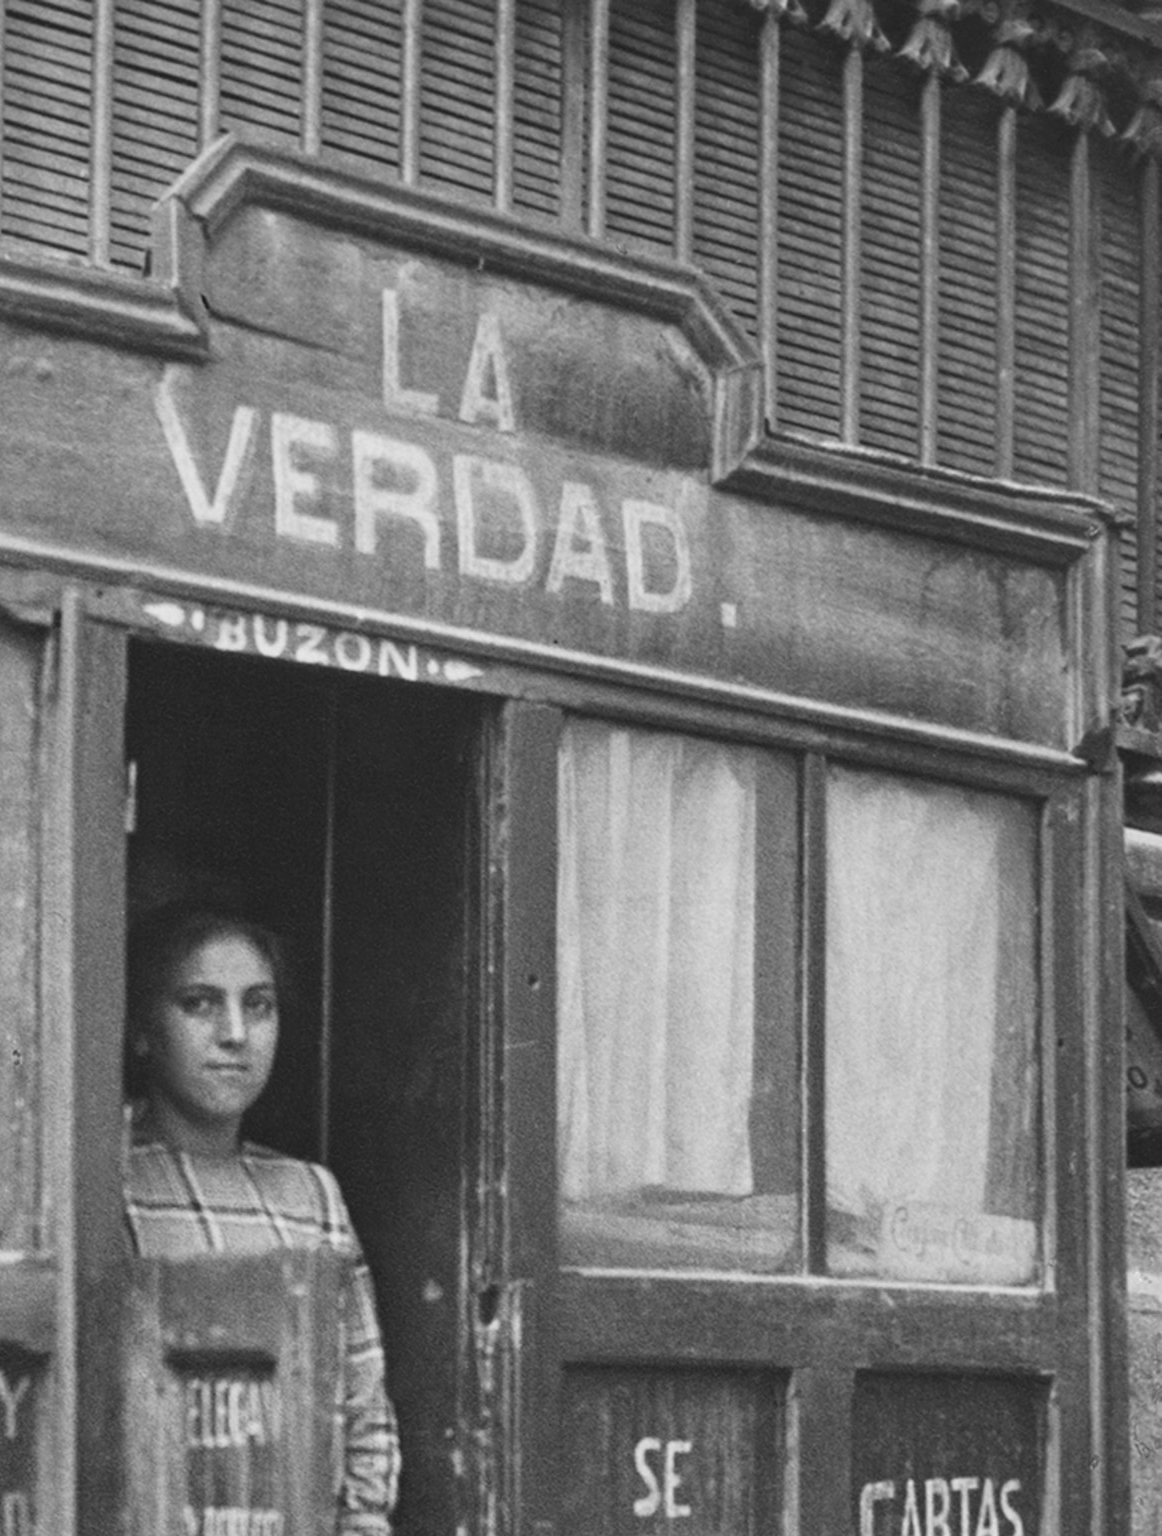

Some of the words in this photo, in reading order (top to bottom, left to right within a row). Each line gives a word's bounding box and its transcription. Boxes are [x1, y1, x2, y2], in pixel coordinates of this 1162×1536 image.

[381, 289, 515, 432] LA
[154, 390, 737, 628] VERDAD.
[214, 614, 418, 682] BUZON
[634, 1436, 692, 1518] SE
